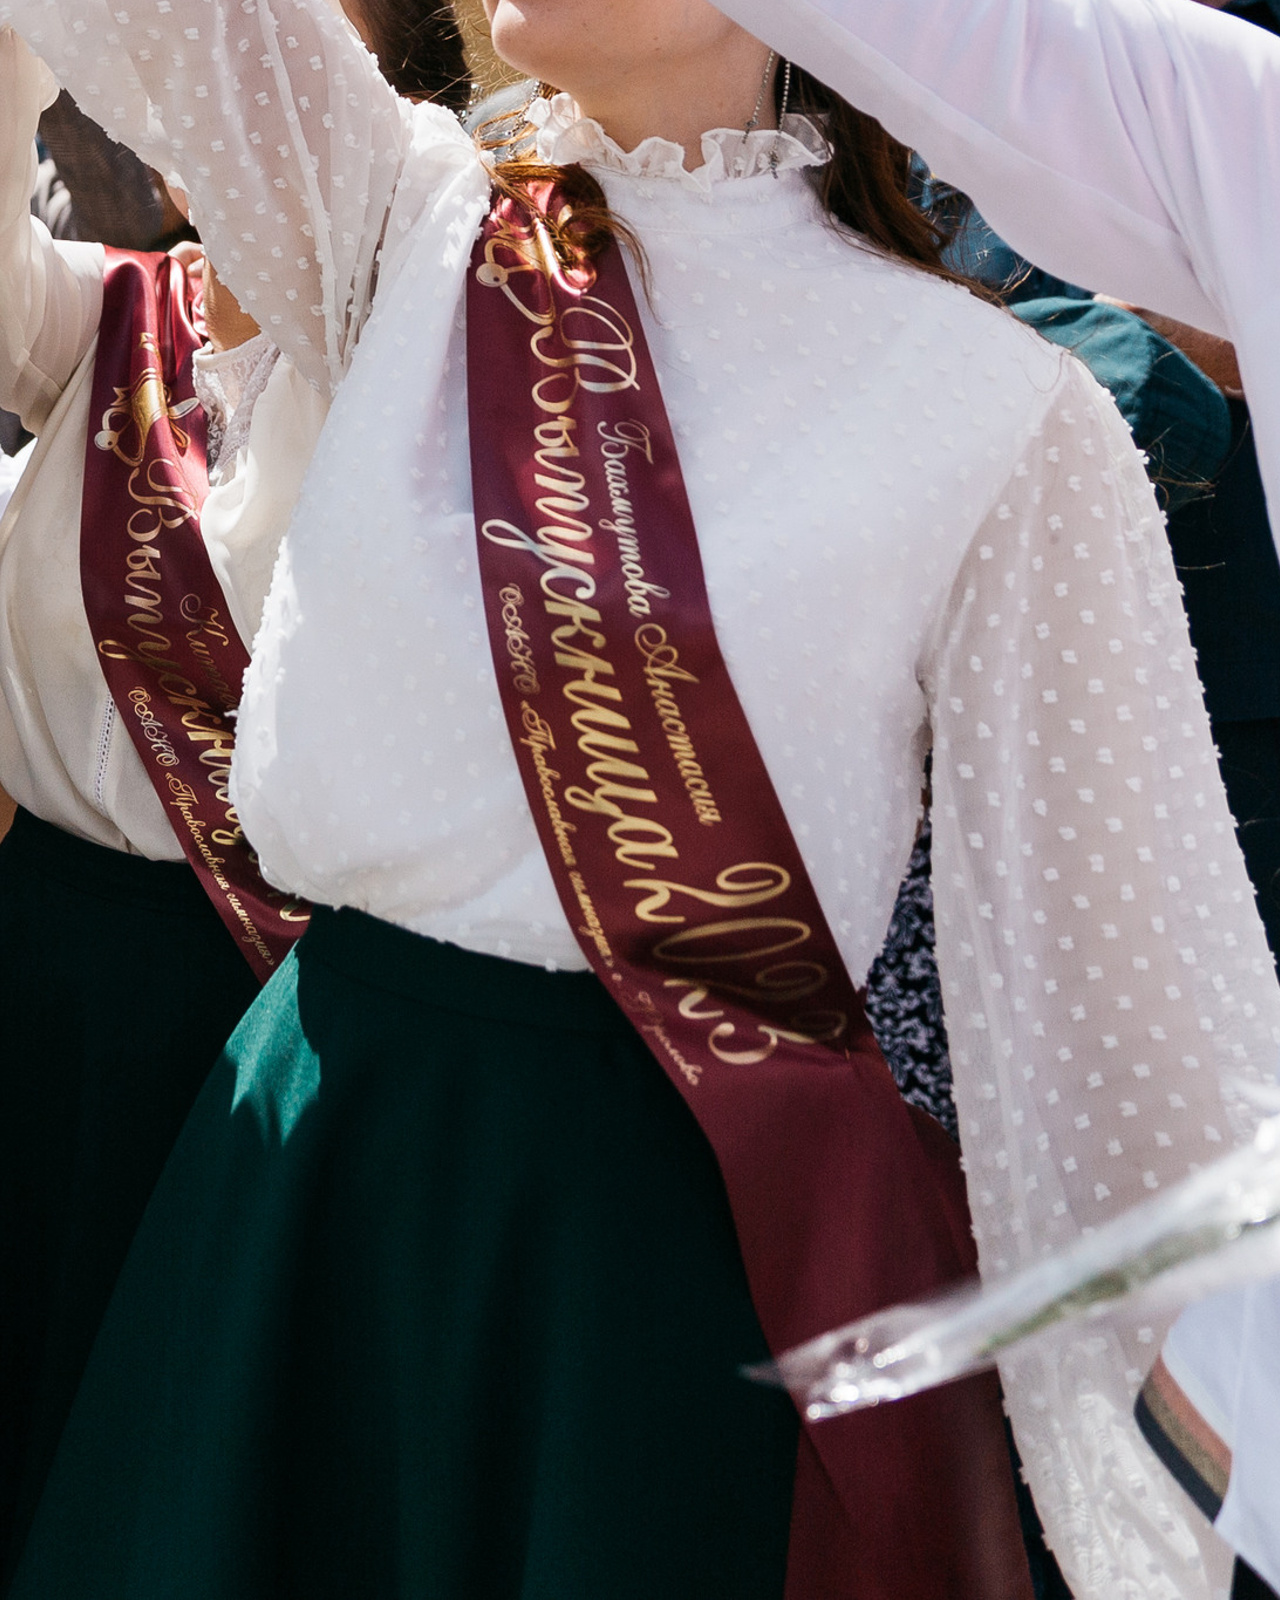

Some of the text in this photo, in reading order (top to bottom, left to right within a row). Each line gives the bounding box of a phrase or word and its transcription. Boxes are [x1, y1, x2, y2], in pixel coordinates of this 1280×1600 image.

[481, 295, 848, 1065] Выпускница 2023
[597, 417, 722, 827] Бахмутова Анастасия
